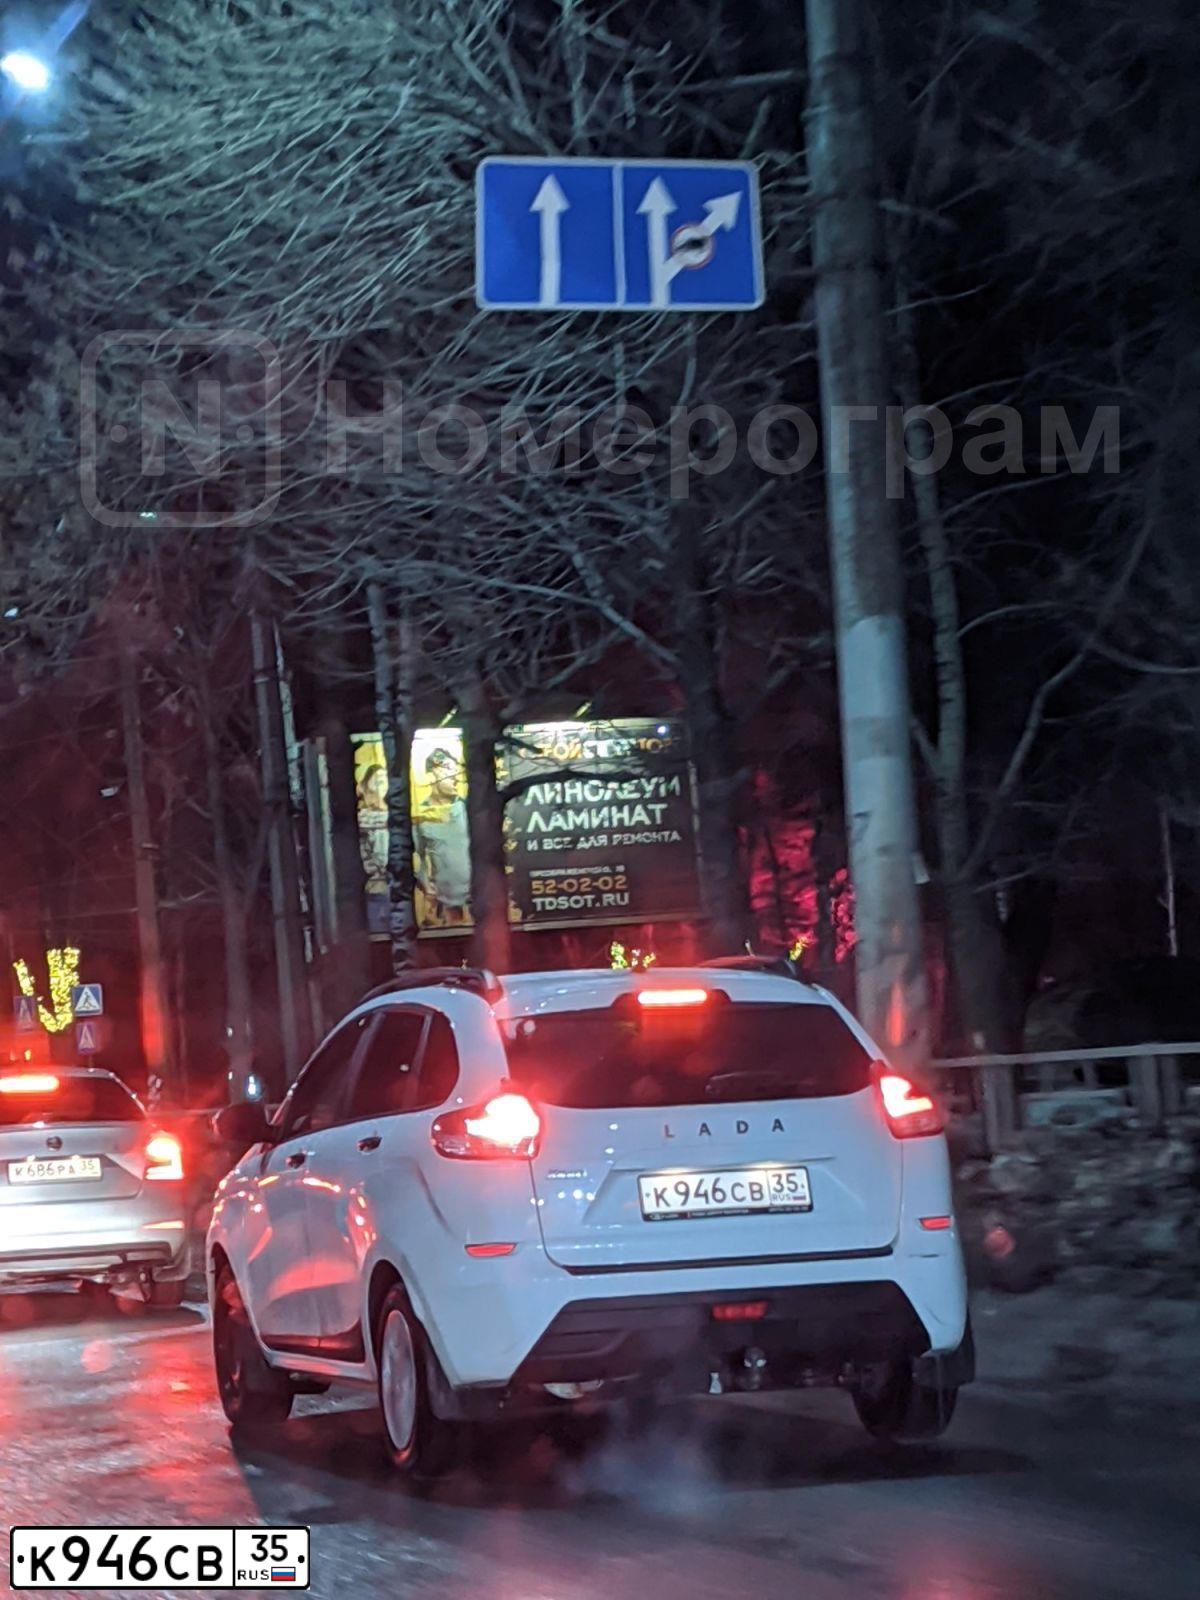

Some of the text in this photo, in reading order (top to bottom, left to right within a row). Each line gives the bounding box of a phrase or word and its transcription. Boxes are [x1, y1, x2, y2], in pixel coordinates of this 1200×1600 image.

[527, 803, 668, 833] ЛАМИНАТ
[527, 839, 538, 851] И
[576, 835, 608, 850] ДЛЯ
[612, 830, 681, 846] РЕМОНТА
[531, 874, 627, 895] 52-02-02
[532, 892, 630, 911] TDSOT.RU
[664, 1118, 785, 1139] LADA
[653, 1173, 798, 1207] К946СВ 35
[772, 1194, 791, 1202] RUS
